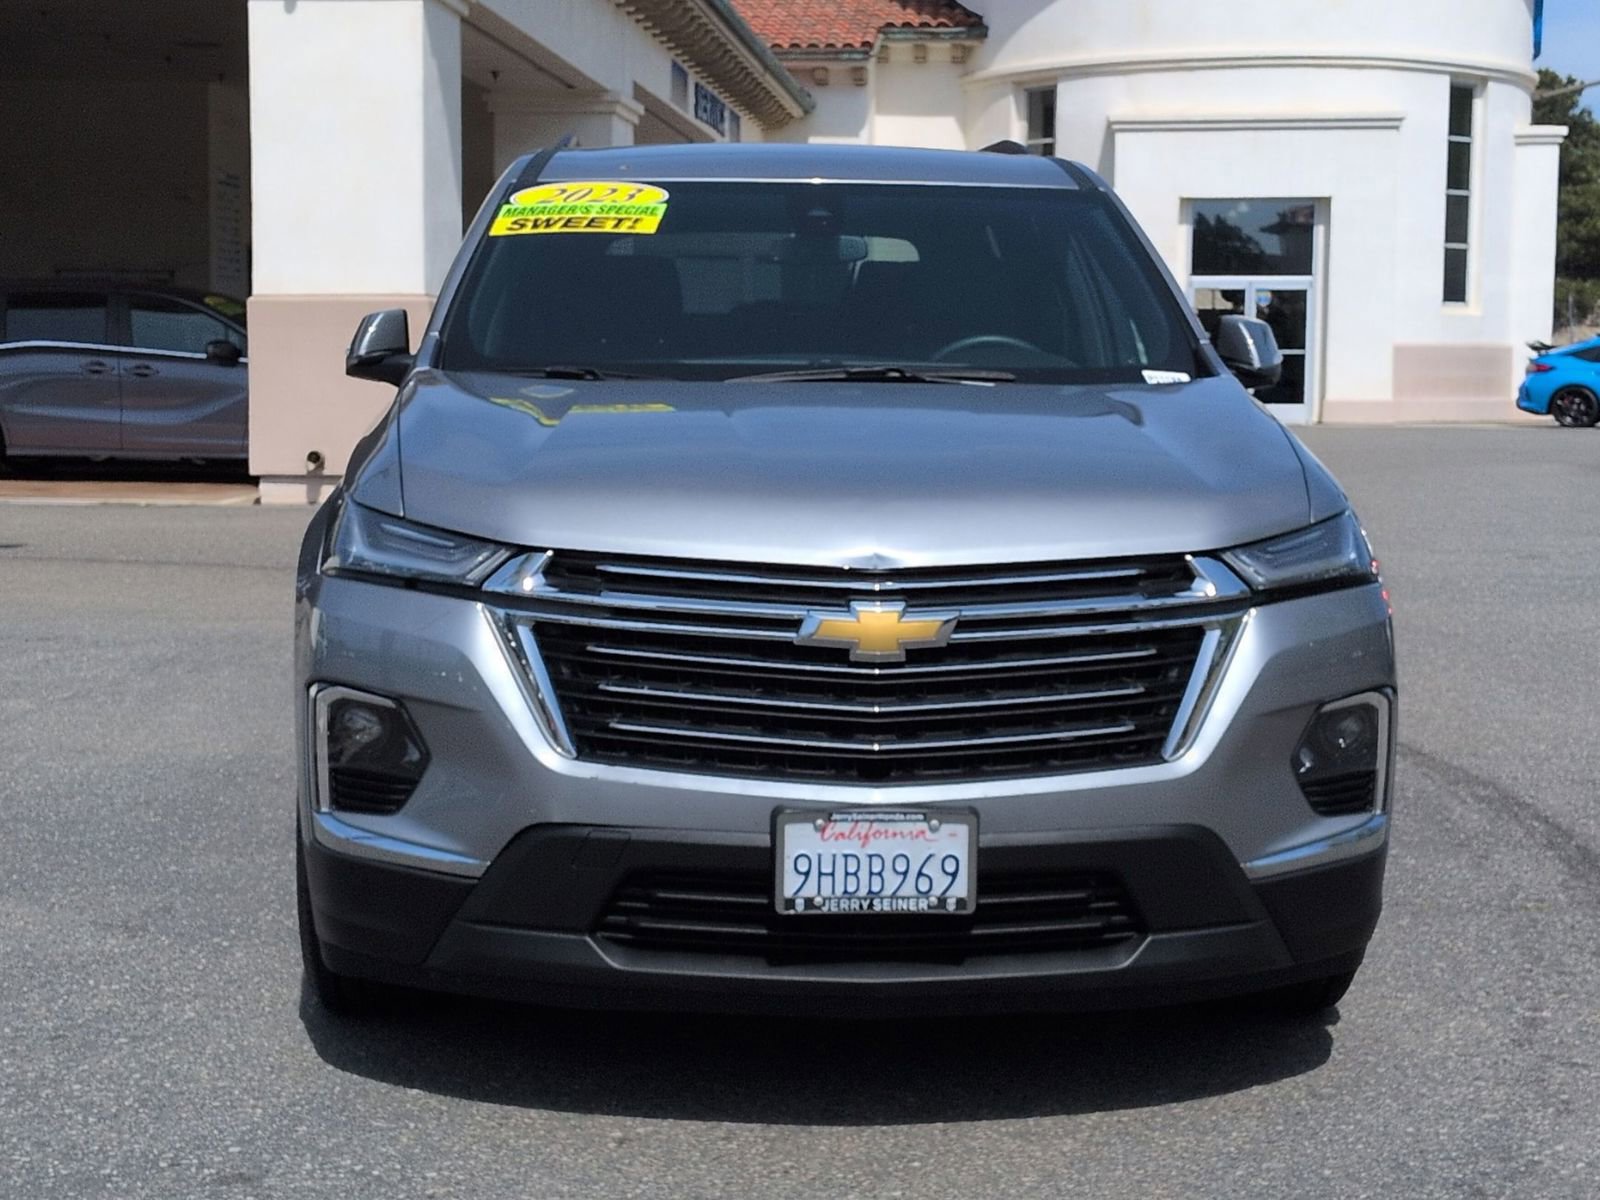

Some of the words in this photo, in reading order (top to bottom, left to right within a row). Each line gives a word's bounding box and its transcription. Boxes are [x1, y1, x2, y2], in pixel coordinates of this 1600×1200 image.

[536, 187, 645, 203] 2023
[502, 204, 594, 216] MANAGER'S
[596, 203, 659, 216] SPECIAL
[506, 216, 643, 232] SWEET!
[820, 820, 939, 848] California
[792, 853, 960, 897] 9HBB969
[820, 897, 870, 912] JERRY
[871, 897, 929, 912] SEINER
